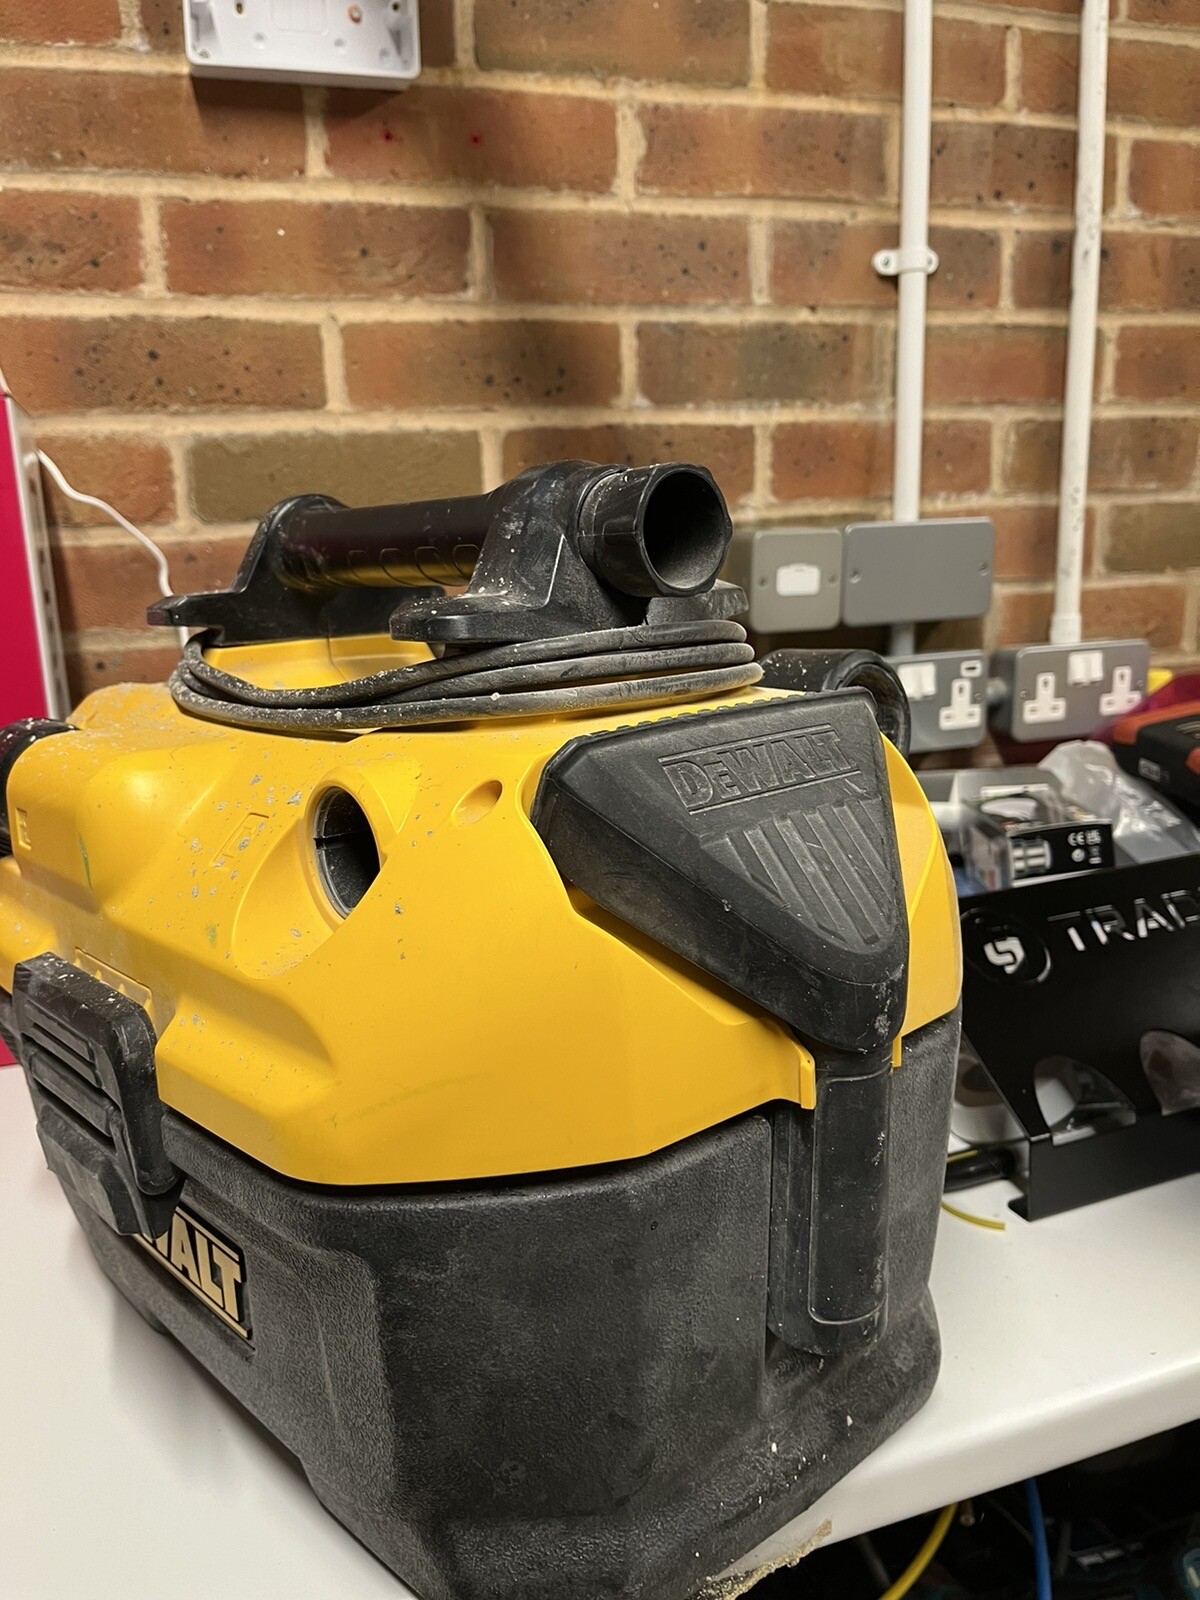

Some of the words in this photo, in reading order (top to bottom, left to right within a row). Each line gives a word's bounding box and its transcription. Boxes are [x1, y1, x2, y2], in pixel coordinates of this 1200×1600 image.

[662, 729, 853, 809] DEWALT
[1047, 889, 1200, 951] TRAD
[143, 1212, 242, 1322] ALT
